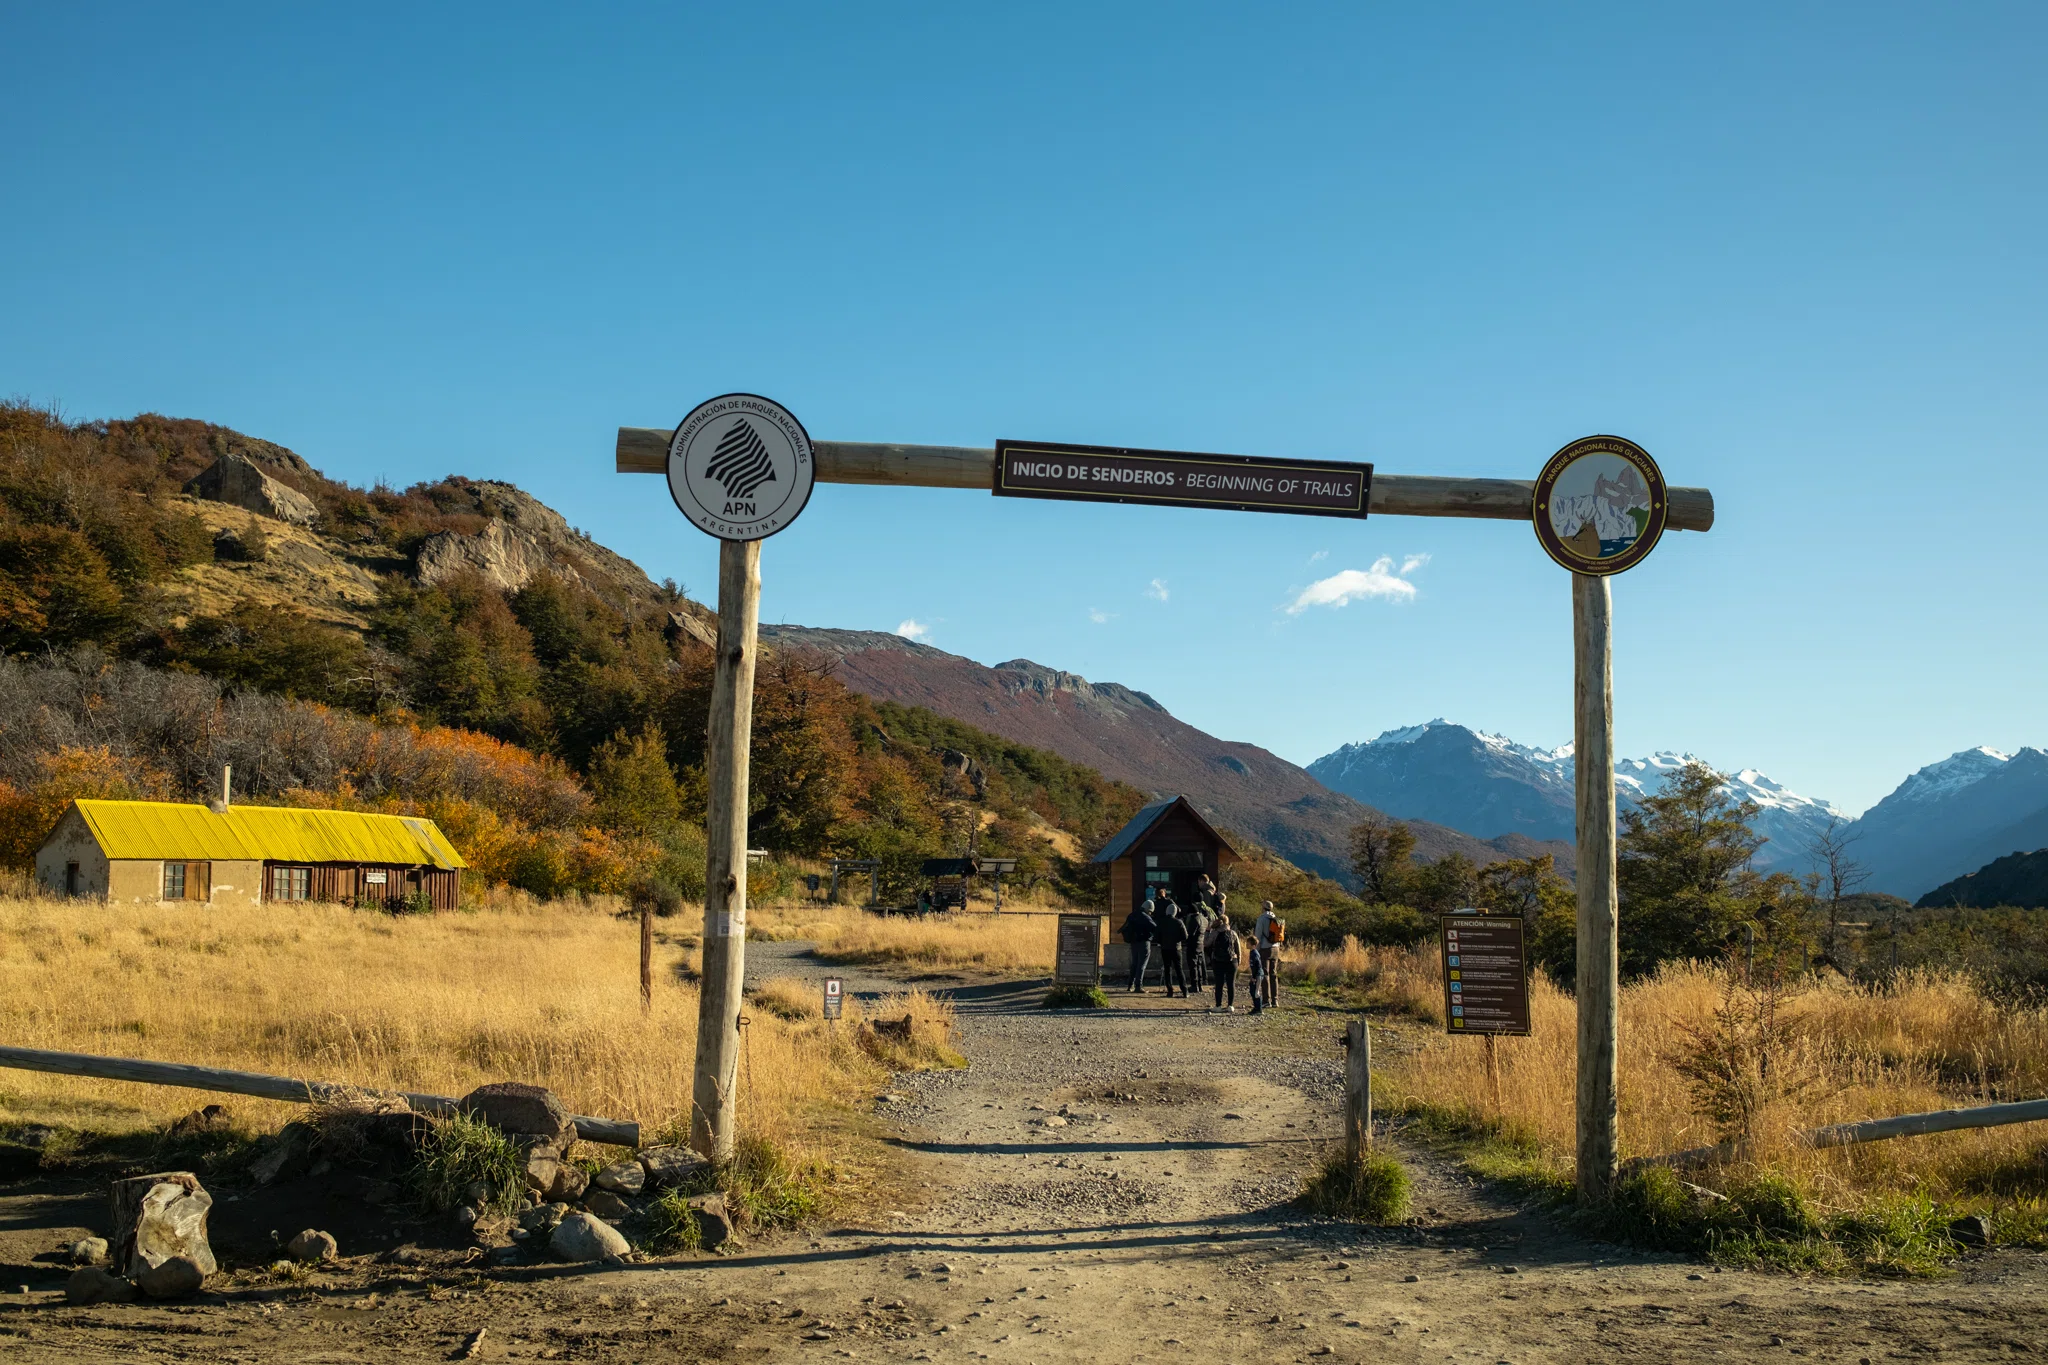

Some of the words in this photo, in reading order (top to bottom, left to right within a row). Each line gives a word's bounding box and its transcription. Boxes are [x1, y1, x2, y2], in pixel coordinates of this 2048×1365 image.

[676, 402, 726, 458] ADMINISTRACIÓN
[741, 400, 779, 418] PARQUES
[778, 416, 807, 464] NACIONALES
[1012, 461, 1063, 478] INICIO
[1066, 465, 1088, 480] DE
[1091, 466, 1175, 486] SENDEROS
[1186, 472, 1274, 492] BEGINNING
[1277, 479, 1299, 493] OF
[1302, 480, 1353, 497] TRAILS
[1546, 456, 1570, 484] PARQUE
[1569, 442, 1608, 459] NACIONAL
[1608, 444, 1624, 453] LOS
[1624, 448, 1656, 483] GLACIARES
[700, 516, 778, 534] ARGENTINA
[722, 502, 756, 516] APN
